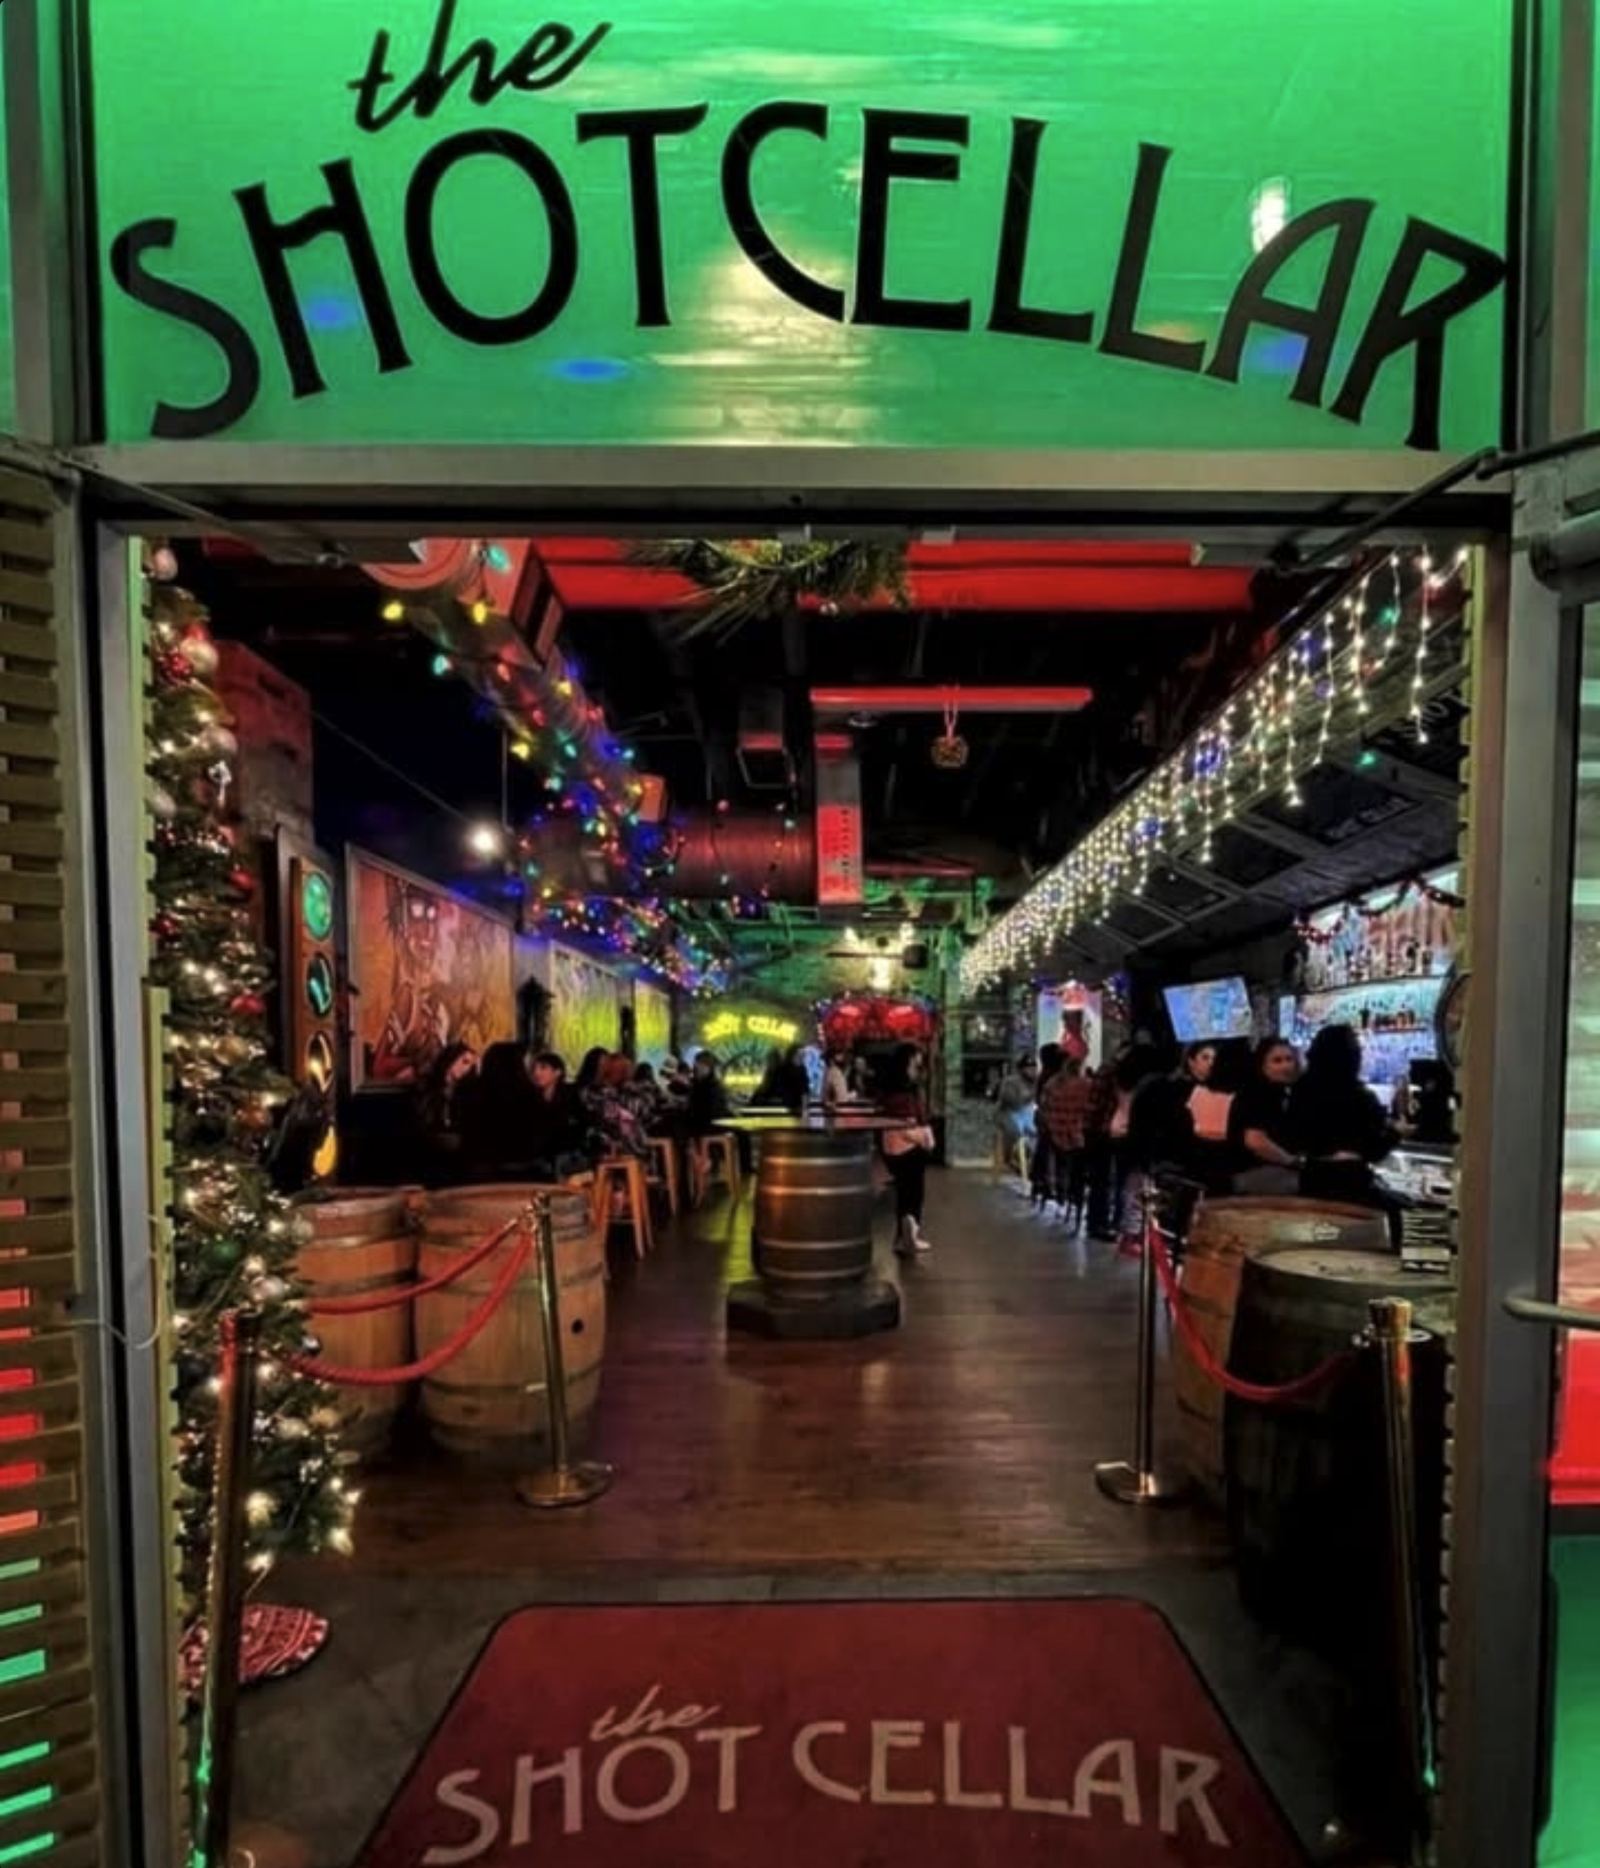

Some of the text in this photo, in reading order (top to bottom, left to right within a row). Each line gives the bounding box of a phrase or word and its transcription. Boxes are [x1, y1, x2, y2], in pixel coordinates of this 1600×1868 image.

[346, 0, 613, 133] the
[589, 1684, 721, 1741] the
[421, 1720, 1230, 1865] SHOT CELLAR
